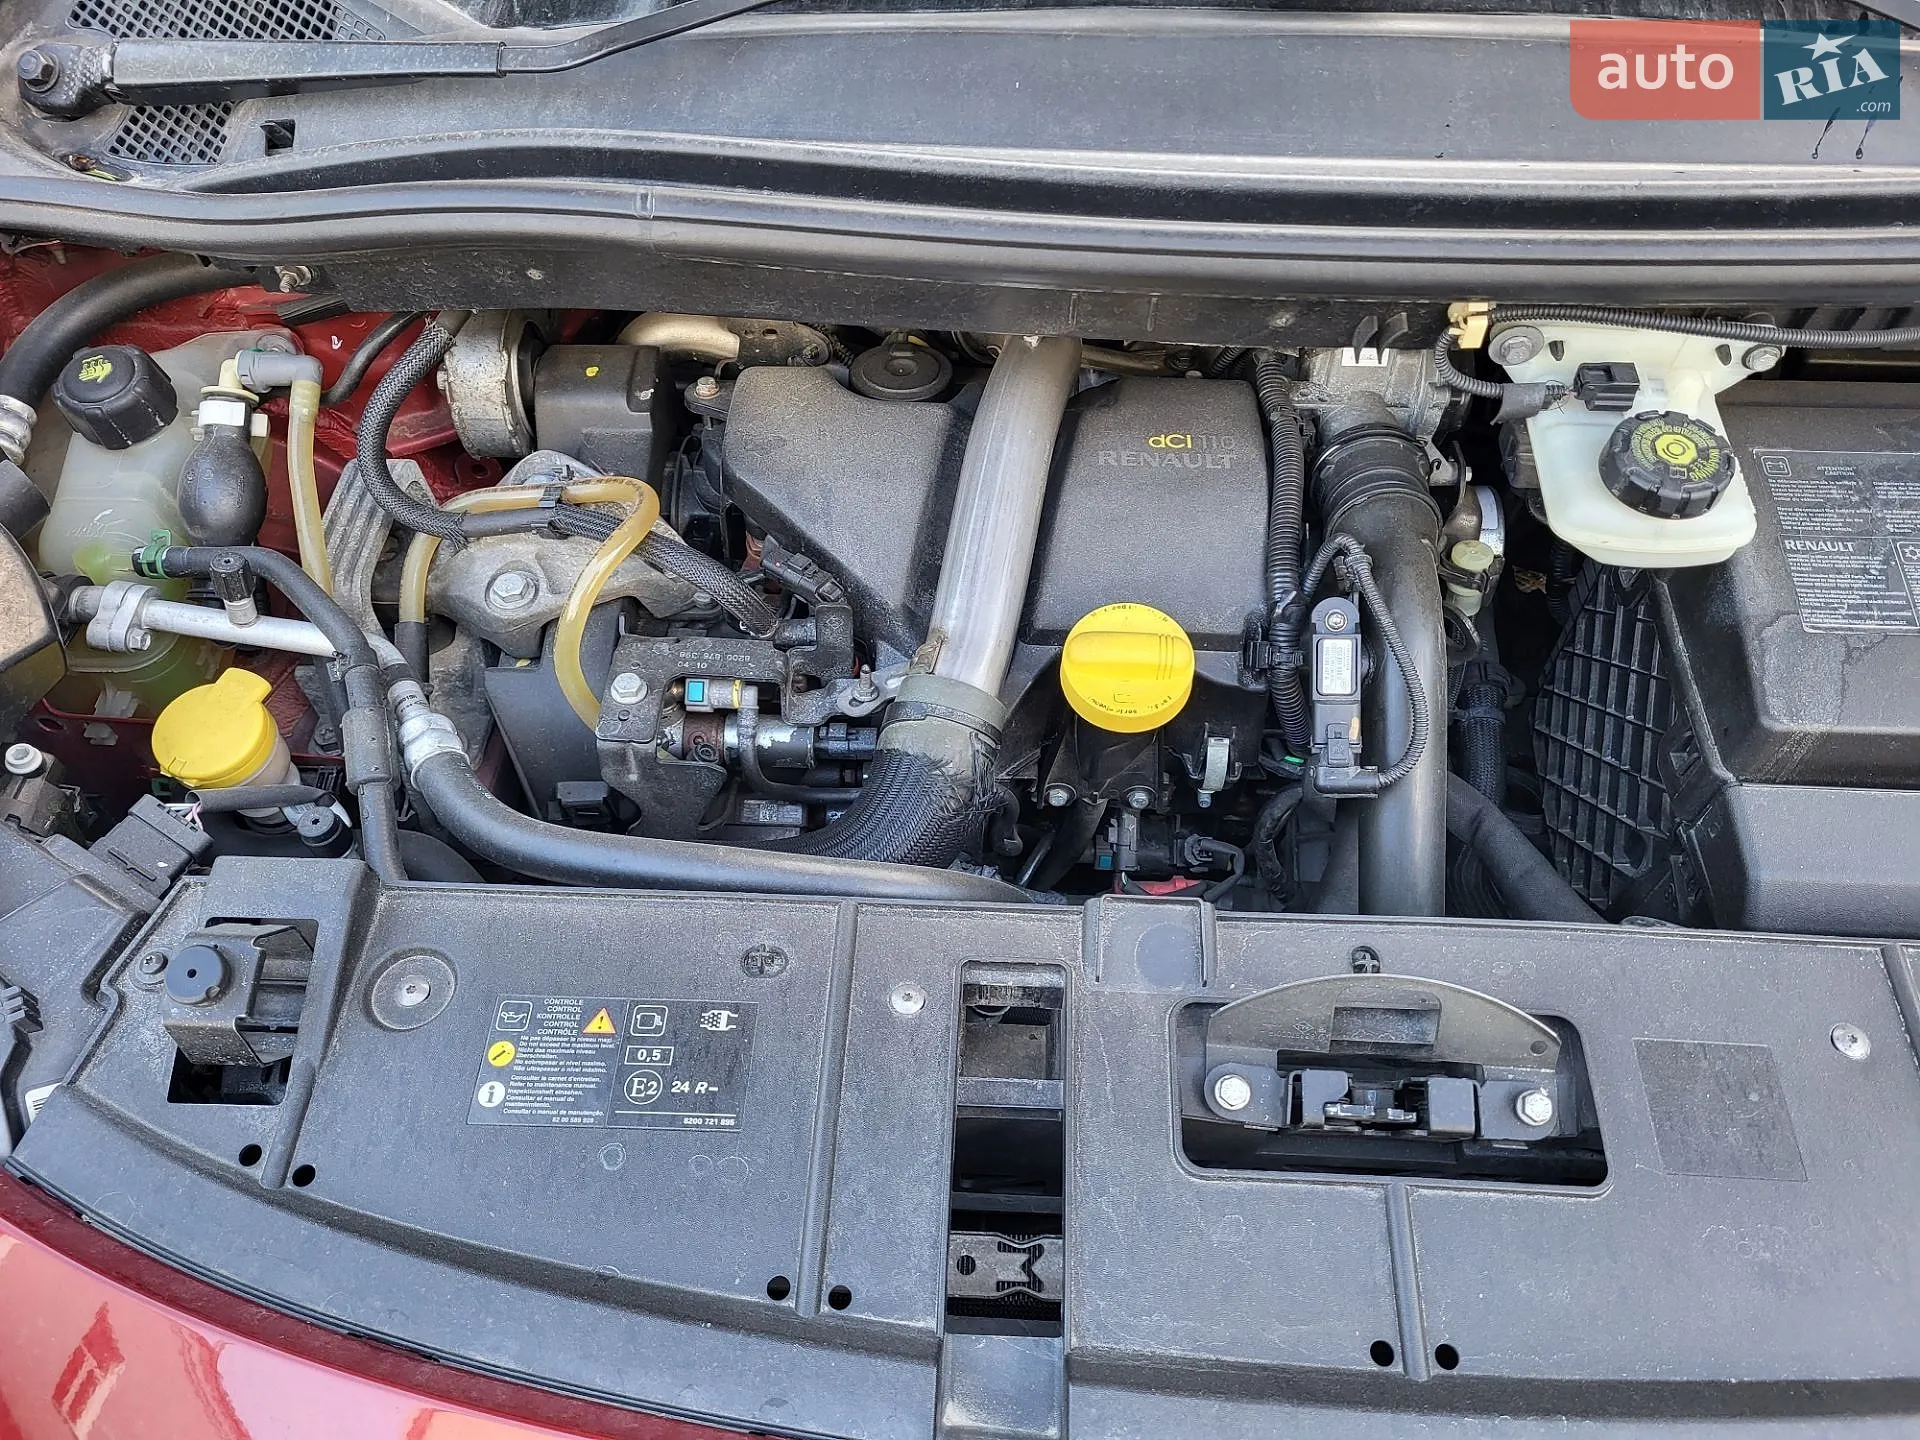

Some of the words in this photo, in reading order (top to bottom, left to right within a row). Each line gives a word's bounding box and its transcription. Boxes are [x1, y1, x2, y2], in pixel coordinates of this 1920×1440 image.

[1099, 450, 1237, 469] RENAULT
[1784, 539, 1855, 552] RENAULT
[544, 1020, 579, 1028] CONTROL
[637, 1048, 662, 1062] 0,5
[630, 1077, 658, 1097] E2
[670, 1080, 690, 1094] 24
